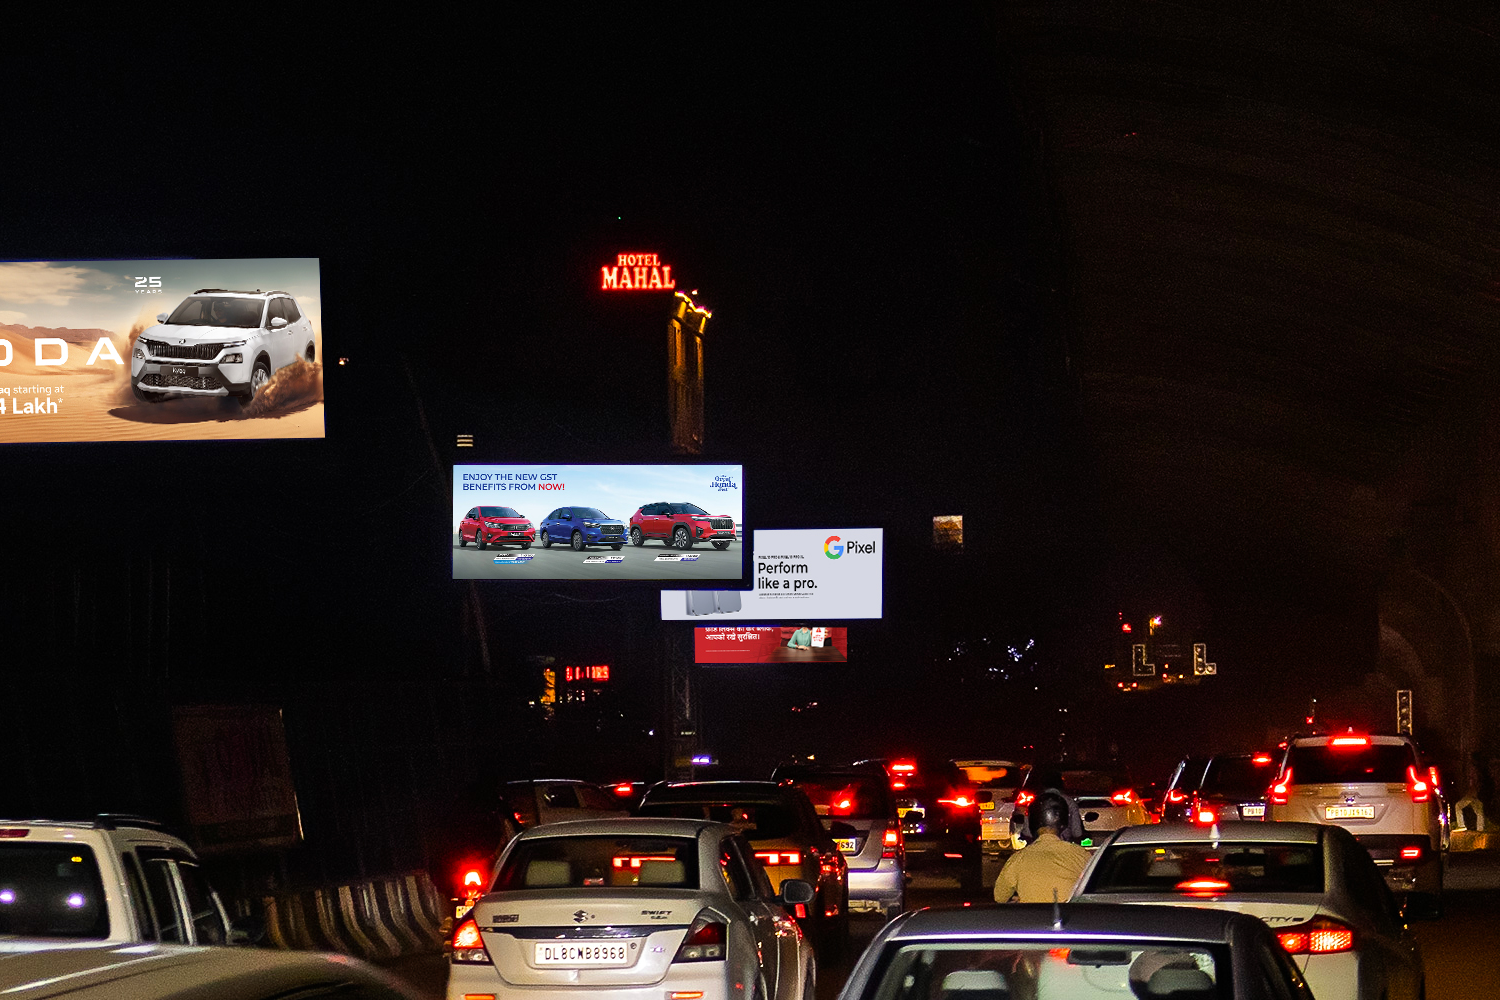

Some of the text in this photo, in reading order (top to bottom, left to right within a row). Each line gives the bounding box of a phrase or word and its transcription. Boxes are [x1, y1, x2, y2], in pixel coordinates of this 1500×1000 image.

[617, 253, 661, 267] HOTEL
[134, 276, 163, 288] 25
[601, 266, 676, 290] MAHAL
[12, 384, 52, 396] starting
[54, 384, 65, 394] at
[462, 473, 558, 481] ENJOY THE NEW GST
[462, 483, 565, 491] BENEFITS FROM NOW!
[846, 541, 876, 554] Pixel
[758, 561, 808, 574] Perform
[758, 576, 818, 592] like a pro.
